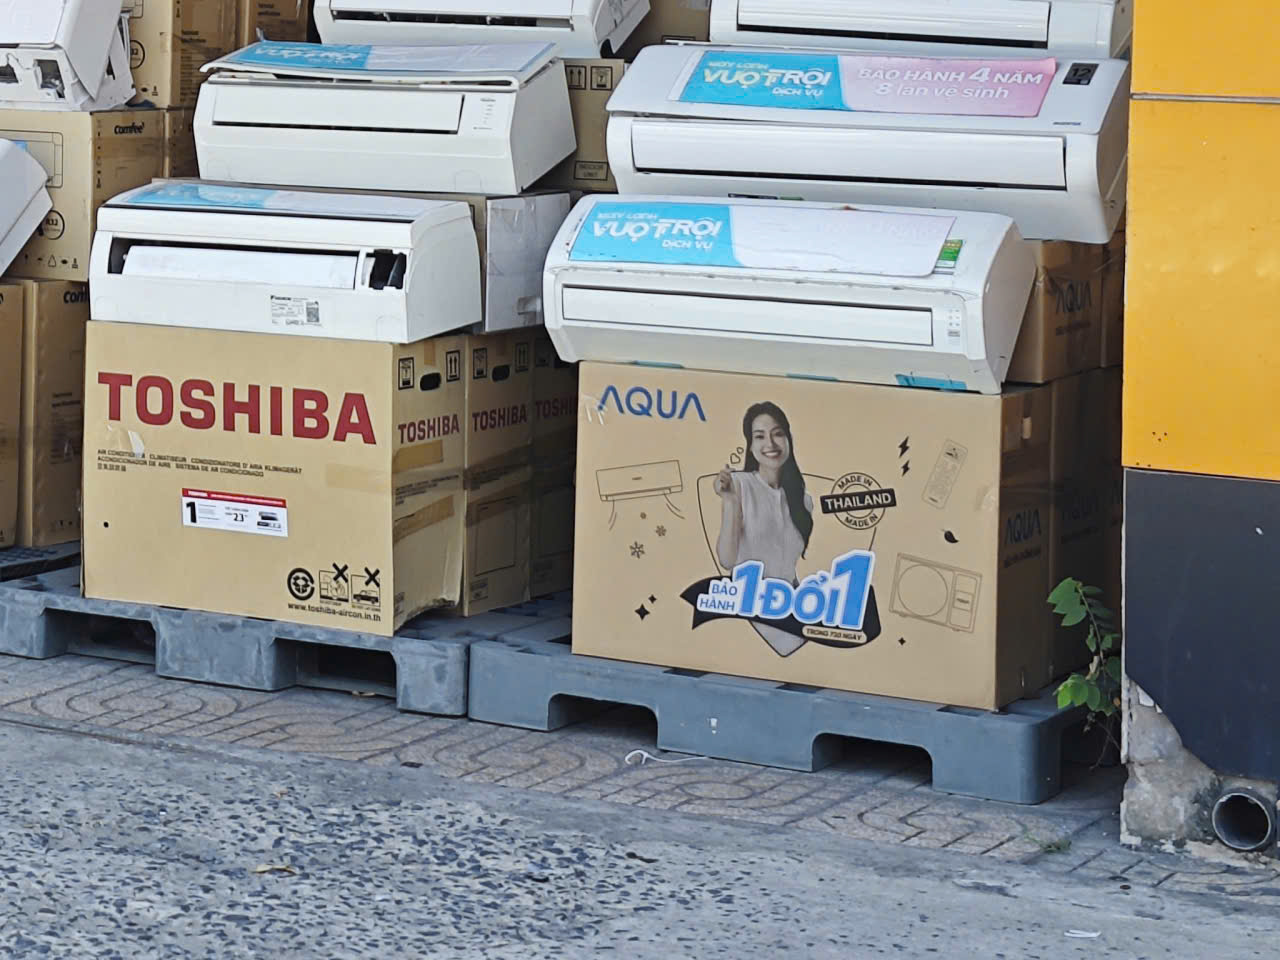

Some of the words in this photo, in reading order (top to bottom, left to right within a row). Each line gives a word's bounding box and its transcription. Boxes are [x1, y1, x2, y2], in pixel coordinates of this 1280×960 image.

[968, 68, 992, 83] 4
[993, 69, 1044, 85] NĂM
[961, 85, 1010, 99] sinh
[97, 371, 377, 445] TOSHIBA
[599, 385, 707, 422] AQUA
[472, 405, 528, 432] TOSHIBA
[398, 414, 460, 444] TOSHIBA
[838, 475, 861, 490] MADE
[863, 478, 873, 487] IN
[825, 492, 892, 511] THAILAND
[186, 501, 197, 523] 1
[845, 515, 869, 528] MADE
[869, 513, 878, 523] IN
[712, 578, 738, 596] BẢO
[734, 564, 762, 614] 1
[834, 555, 872, 627] 1
[699, 593, 735, 611] HÀNH
